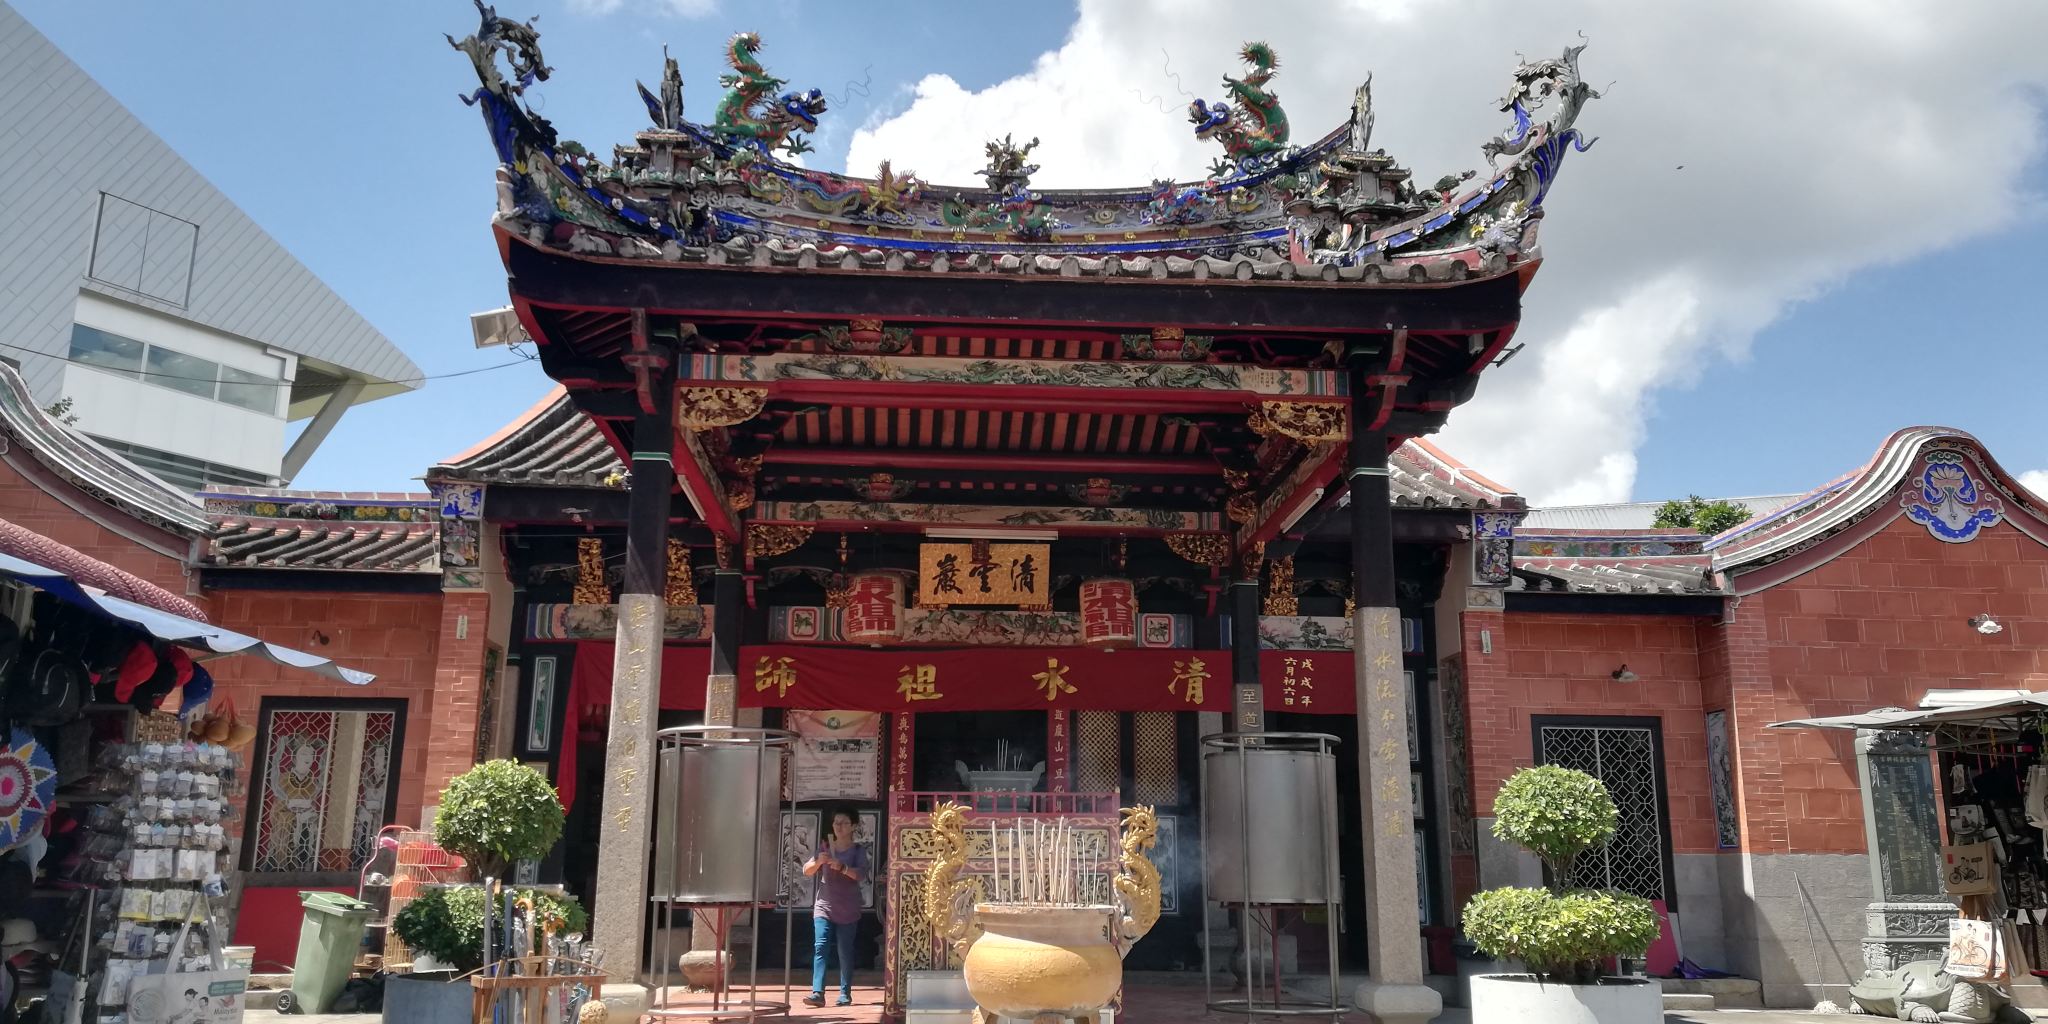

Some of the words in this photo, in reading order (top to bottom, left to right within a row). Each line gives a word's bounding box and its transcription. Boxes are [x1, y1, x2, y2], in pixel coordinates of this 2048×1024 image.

[755, 655, 1213, 704] 清水祖師
[1283, 657, 1298, 706] 六月初六日
